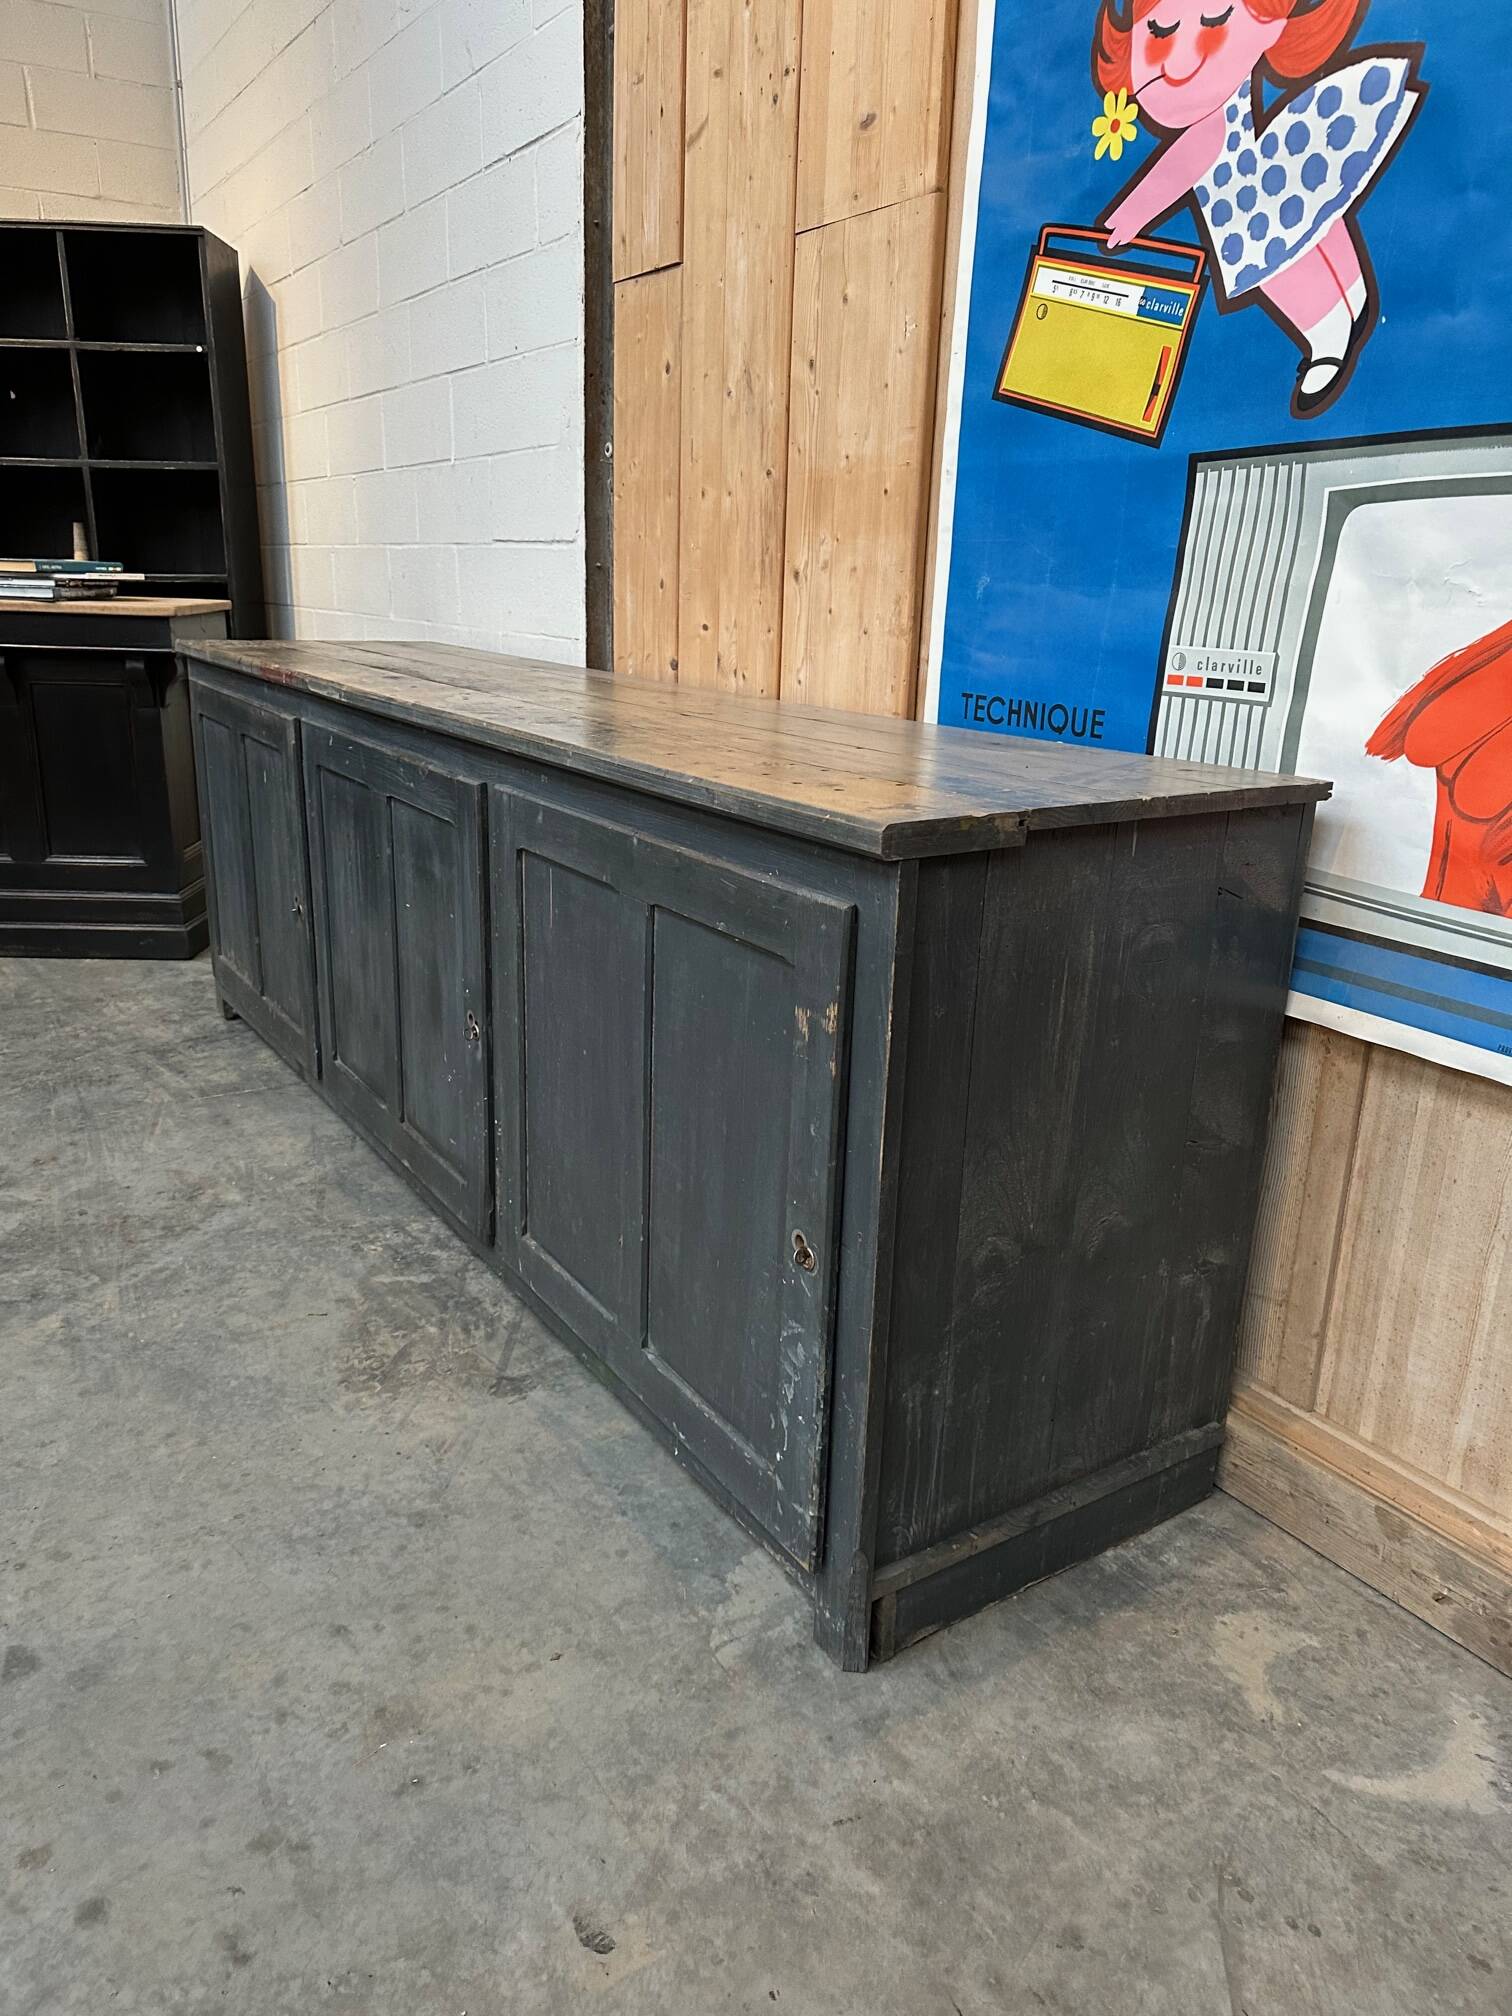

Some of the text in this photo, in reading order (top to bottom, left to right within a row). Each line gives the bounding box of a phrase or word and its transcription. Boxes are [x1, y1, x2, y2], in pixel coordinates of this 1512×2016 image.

[1145, 297, 1185, 317] clarville
[1196, 656, 1263, 676] clarville
[961, 692, 1106, 740] TECHNIQUE
